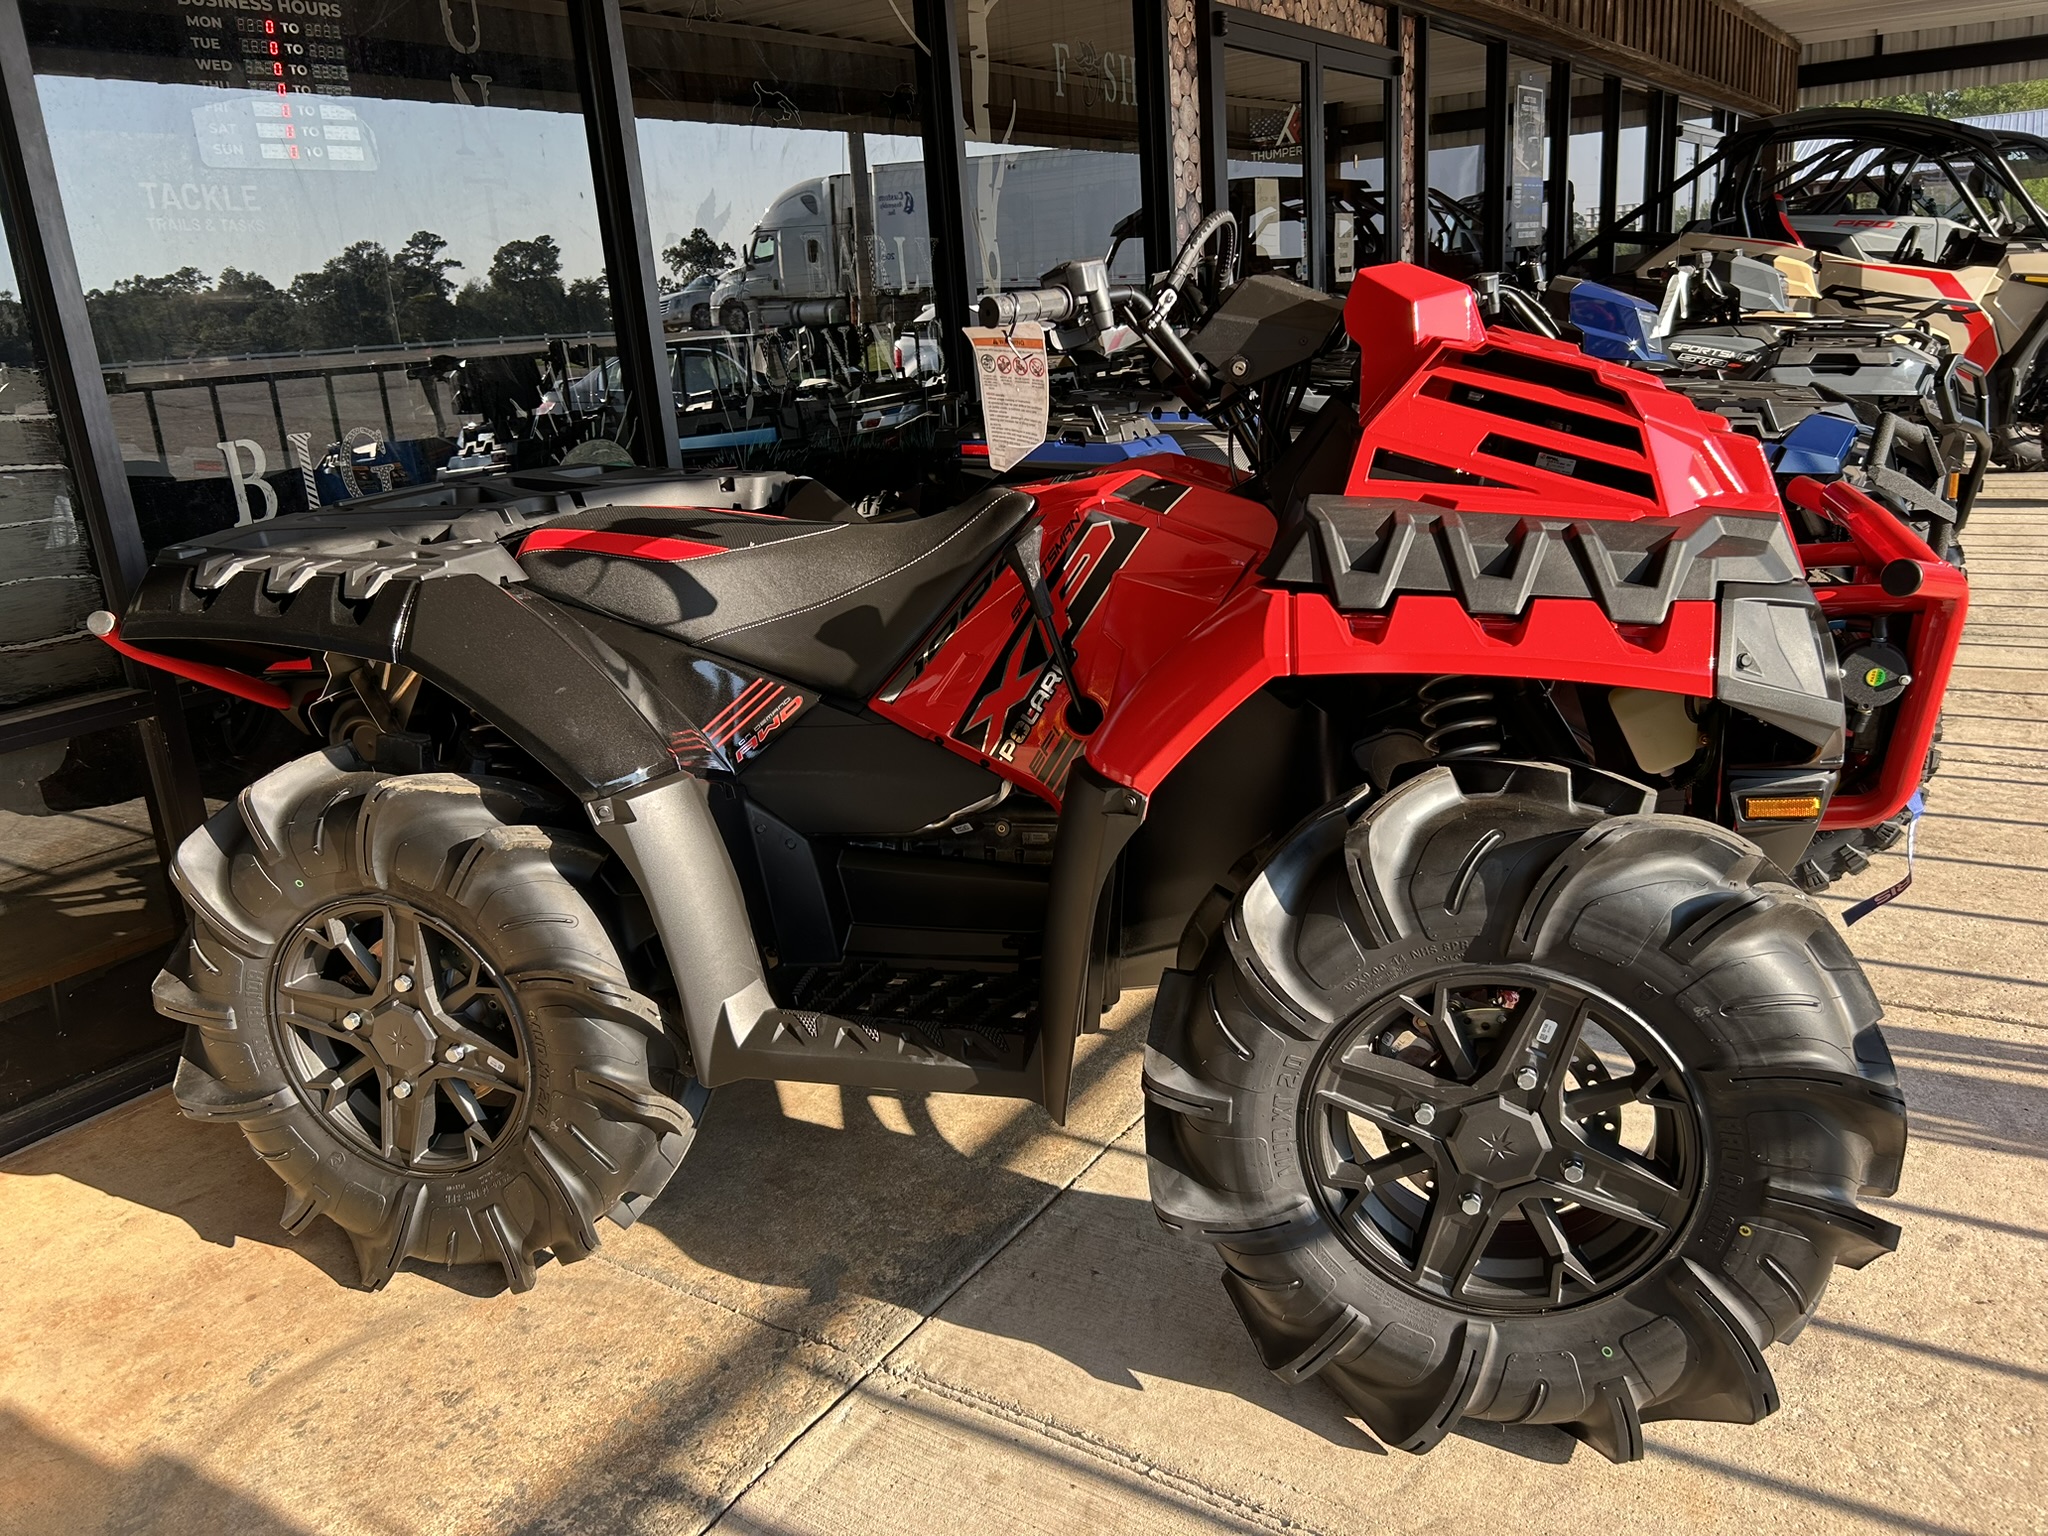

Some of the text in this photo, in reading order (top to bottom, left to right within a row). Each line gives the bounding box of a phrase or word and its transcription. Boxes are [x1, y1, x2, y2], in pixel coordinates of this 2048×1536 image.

[278, 0, 342, 18] HOURS
[185, 15, 223, 29] MON
[280, 22, 300, 34] TO
[190, 37, 221, 50] TUE
[284, 43, 304, 55] TO
[195, 58, 233, 71] WED
[288, 64, 308, 75] TO
[1052, 38, 1138, 106] FSH
[292, 85, 312, 96] TO
[204, 102, 229, 114] FRI
[296, 105, 315, 117] TO
[208, 122, 237, 135] SAT
[300, 125, 320, 138] TO
[212, 143, 244, 156] SUN
[304, 145, 324, 158] TO
[1251, 146, 1303, 161] THUMPER
[138, 182, 262, 211] TACKLE
[145, 217, 267, 233] TRAILS & TASKS
[1668, 342, 1763, 362] SPORTSMAN
[1010, 511, 1083, 624] SPTSMAN
[1000, 648, 1078, 764] POLARI
[735, 694, 804, 763] AWD
[1030, 727, 1062, 773] EFI
